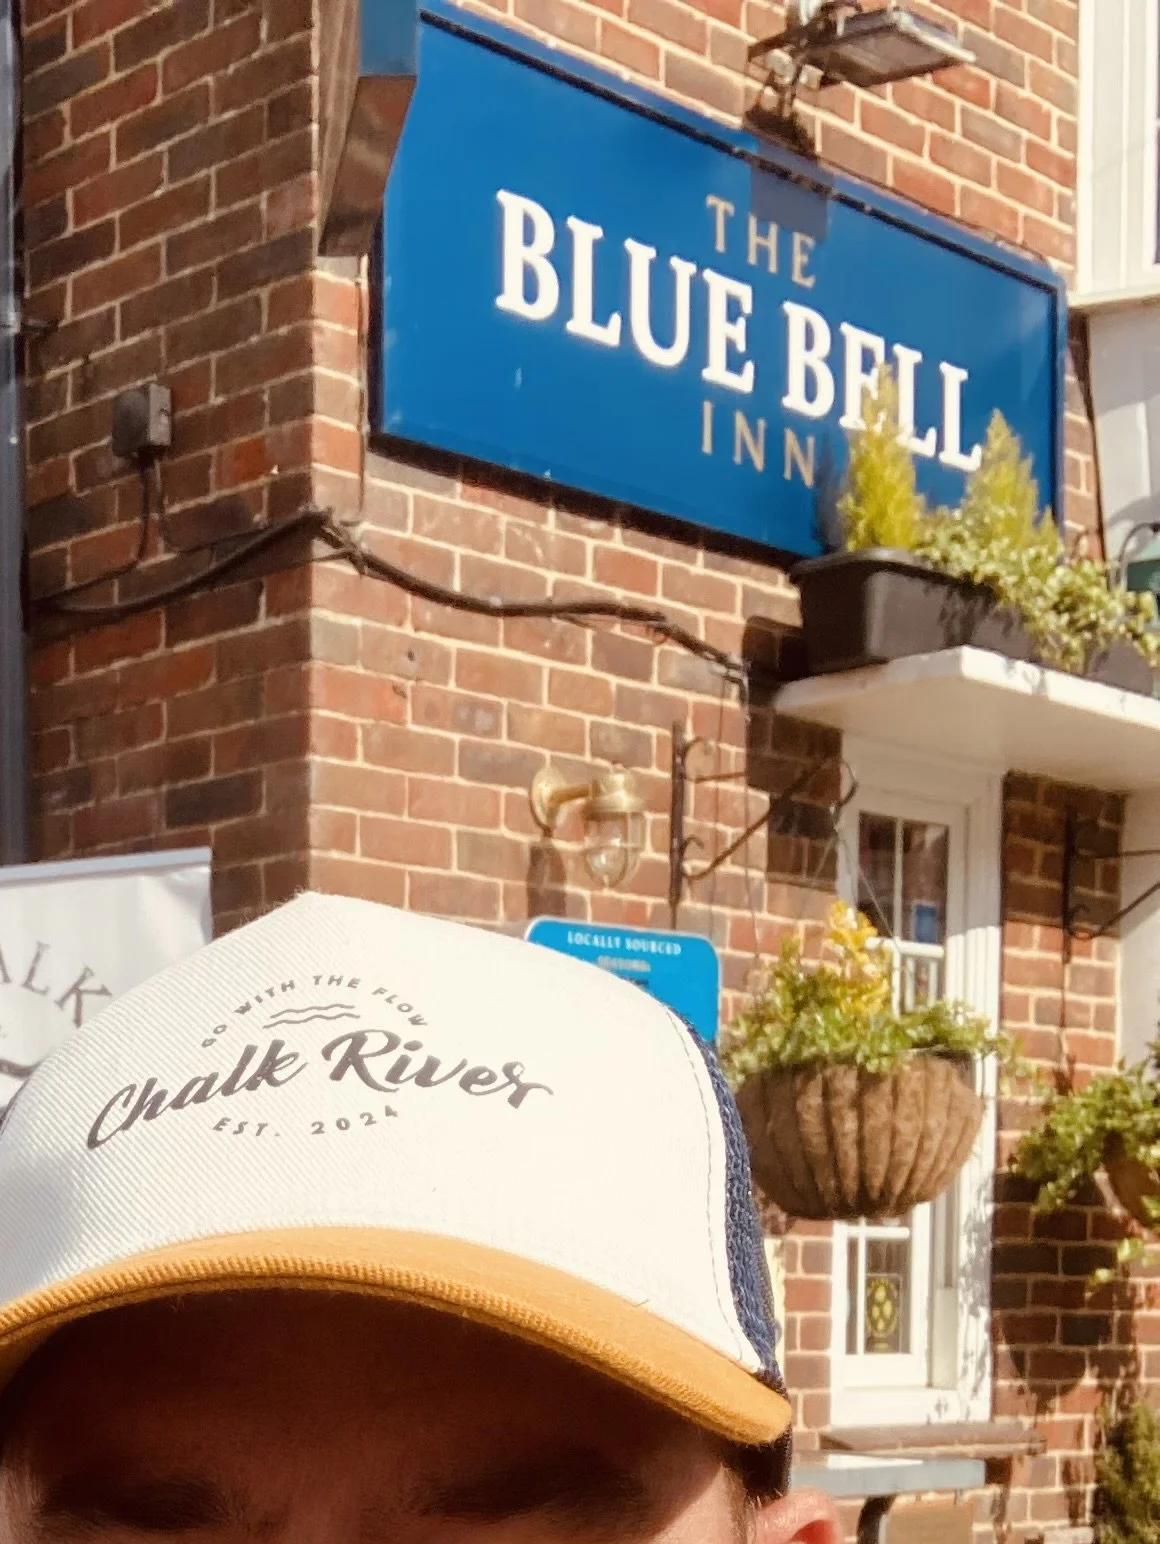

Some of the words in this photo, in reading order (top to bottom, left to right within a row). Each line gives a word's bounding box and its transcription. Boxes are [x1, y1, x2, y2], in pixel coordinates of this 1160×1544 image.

[705, 194, 817, 289] THE
[495, 189, 756, 395] BLUE
[781, 300, 983, 472] BELL
[701, 401, 818, 489] INN
[567, 930, 621, 949] LOCALLY
[624, 937, 682, 956] SOURCED
[201, 1023, 228, 1048] GO
[234, 979, 296, 1015] WITH
[312, 974, 362, 989] THE
[371, 986, 429, 1027] FLOW
[86, 1038, 309, 1151] Chalk
[321, 1029, 555, 1110] River
[212, 1116, 281, 1138] EST.
[310, 1105, 400, 1136] 2024
